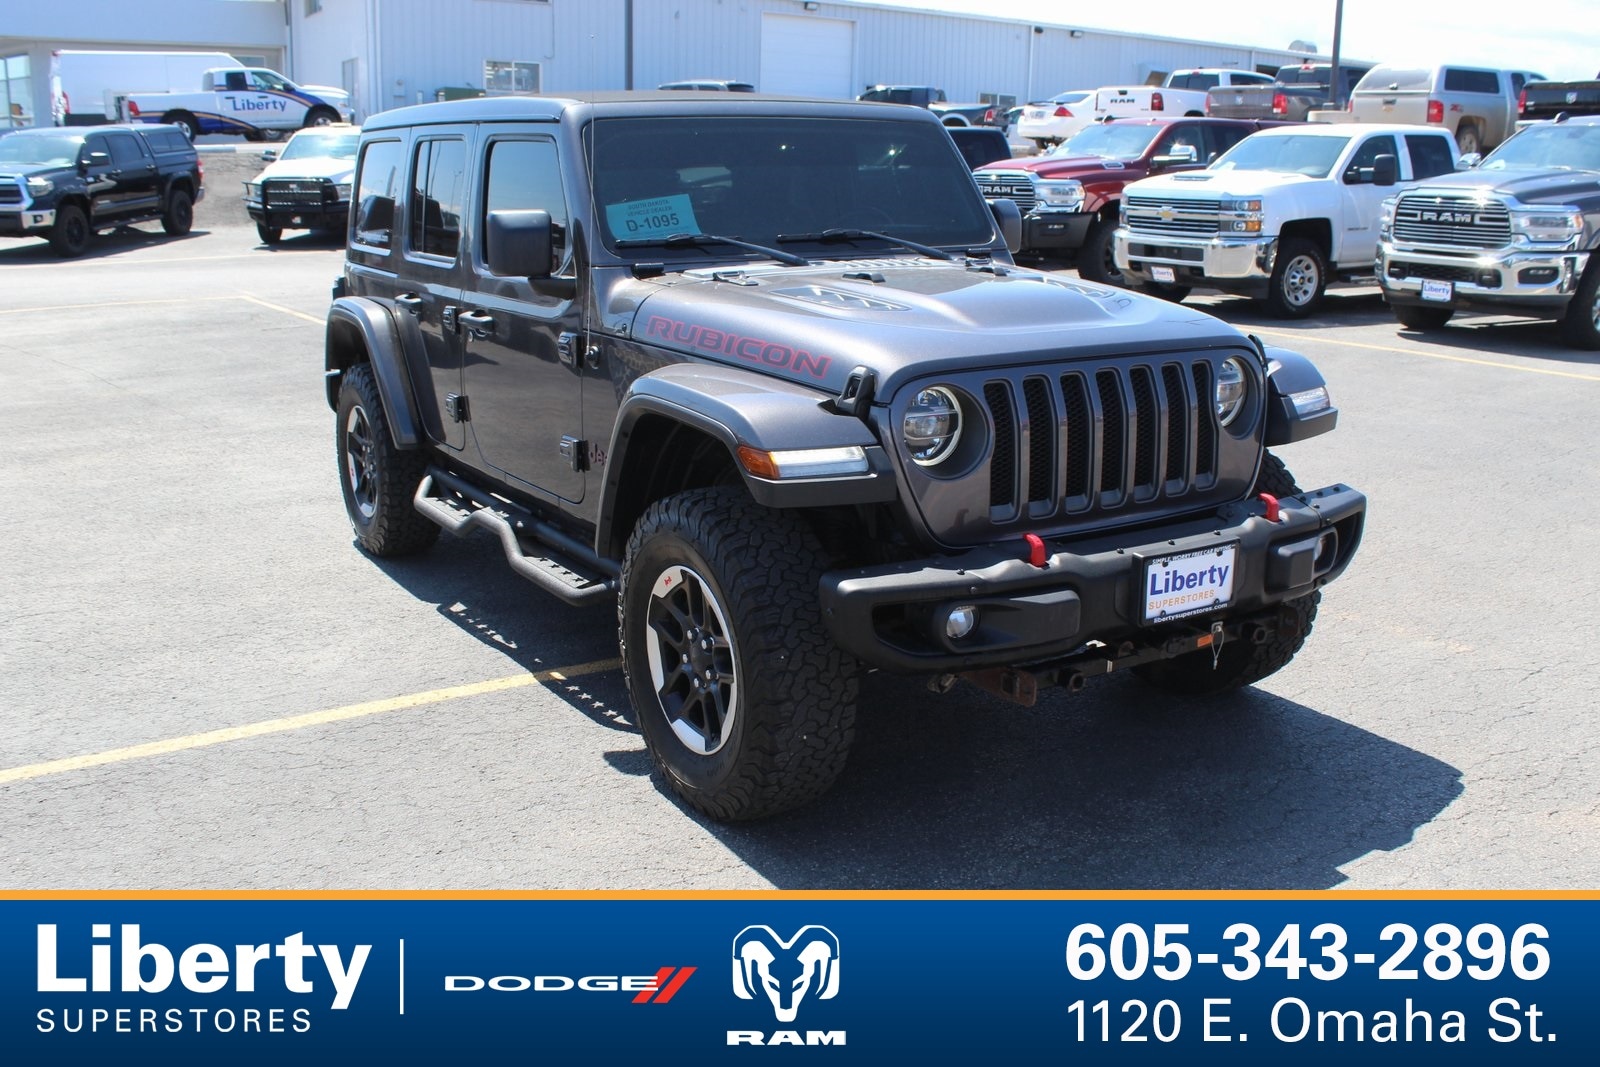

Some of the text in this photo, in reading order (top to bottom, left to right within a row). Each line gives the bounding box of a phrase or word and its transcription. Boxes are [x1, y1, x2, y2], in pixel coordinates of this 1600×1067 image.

[232, 99, 286, 112] Liberty
[983, 185, 1011, 193] RAM
[625, 213, 679, 232] D-1095
[1422, 211, 1472, 223] RAM
[1424, 284, 1450, 295] Liberty
[646, 315, 832, 380] RUBICON
[1150, 564, 1229, 596] Liberty
[1148, 589, 1215, 610] SUPERSTORES
[1153, 603, 1228, 624] libertysuperstores.com
